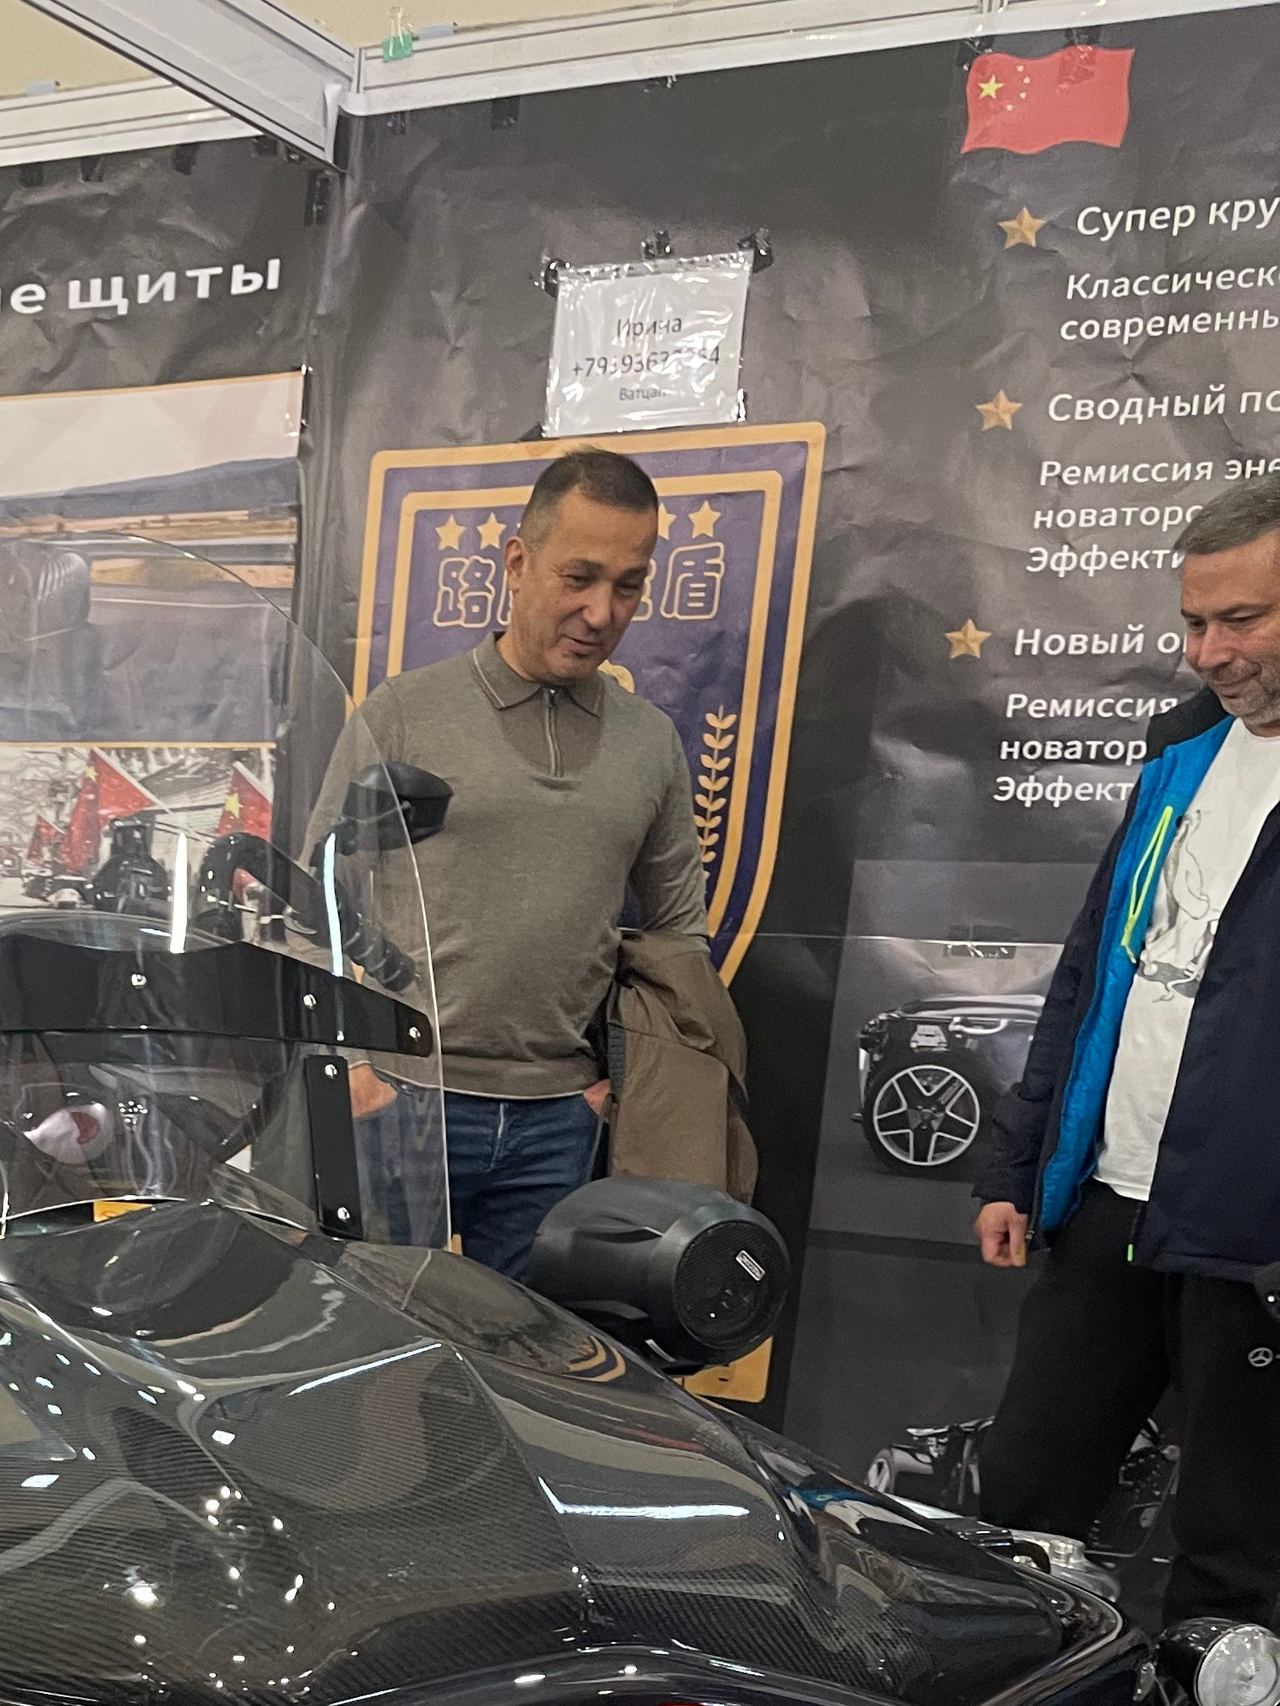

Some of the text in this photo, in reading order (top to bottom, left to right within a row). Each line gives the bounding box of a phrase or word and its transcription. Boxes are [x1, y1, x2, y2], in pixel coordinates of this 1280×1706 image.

[1076, 205, 1196, 242] Супер
[68, 256, 281, 316] щиты
[1065, 265, 1280, 301] Классическ
[1047, 382, 1227, 427] Сводный
[1039, 460, 1214, 486] Ремиссия
[1014, 622, 1187, 657] Новый о
[1006, 692, 1178, 719] Ремиссия
[999, 739, 1148, 767] новатор
[992, 774, 1136, 809] Эффект
